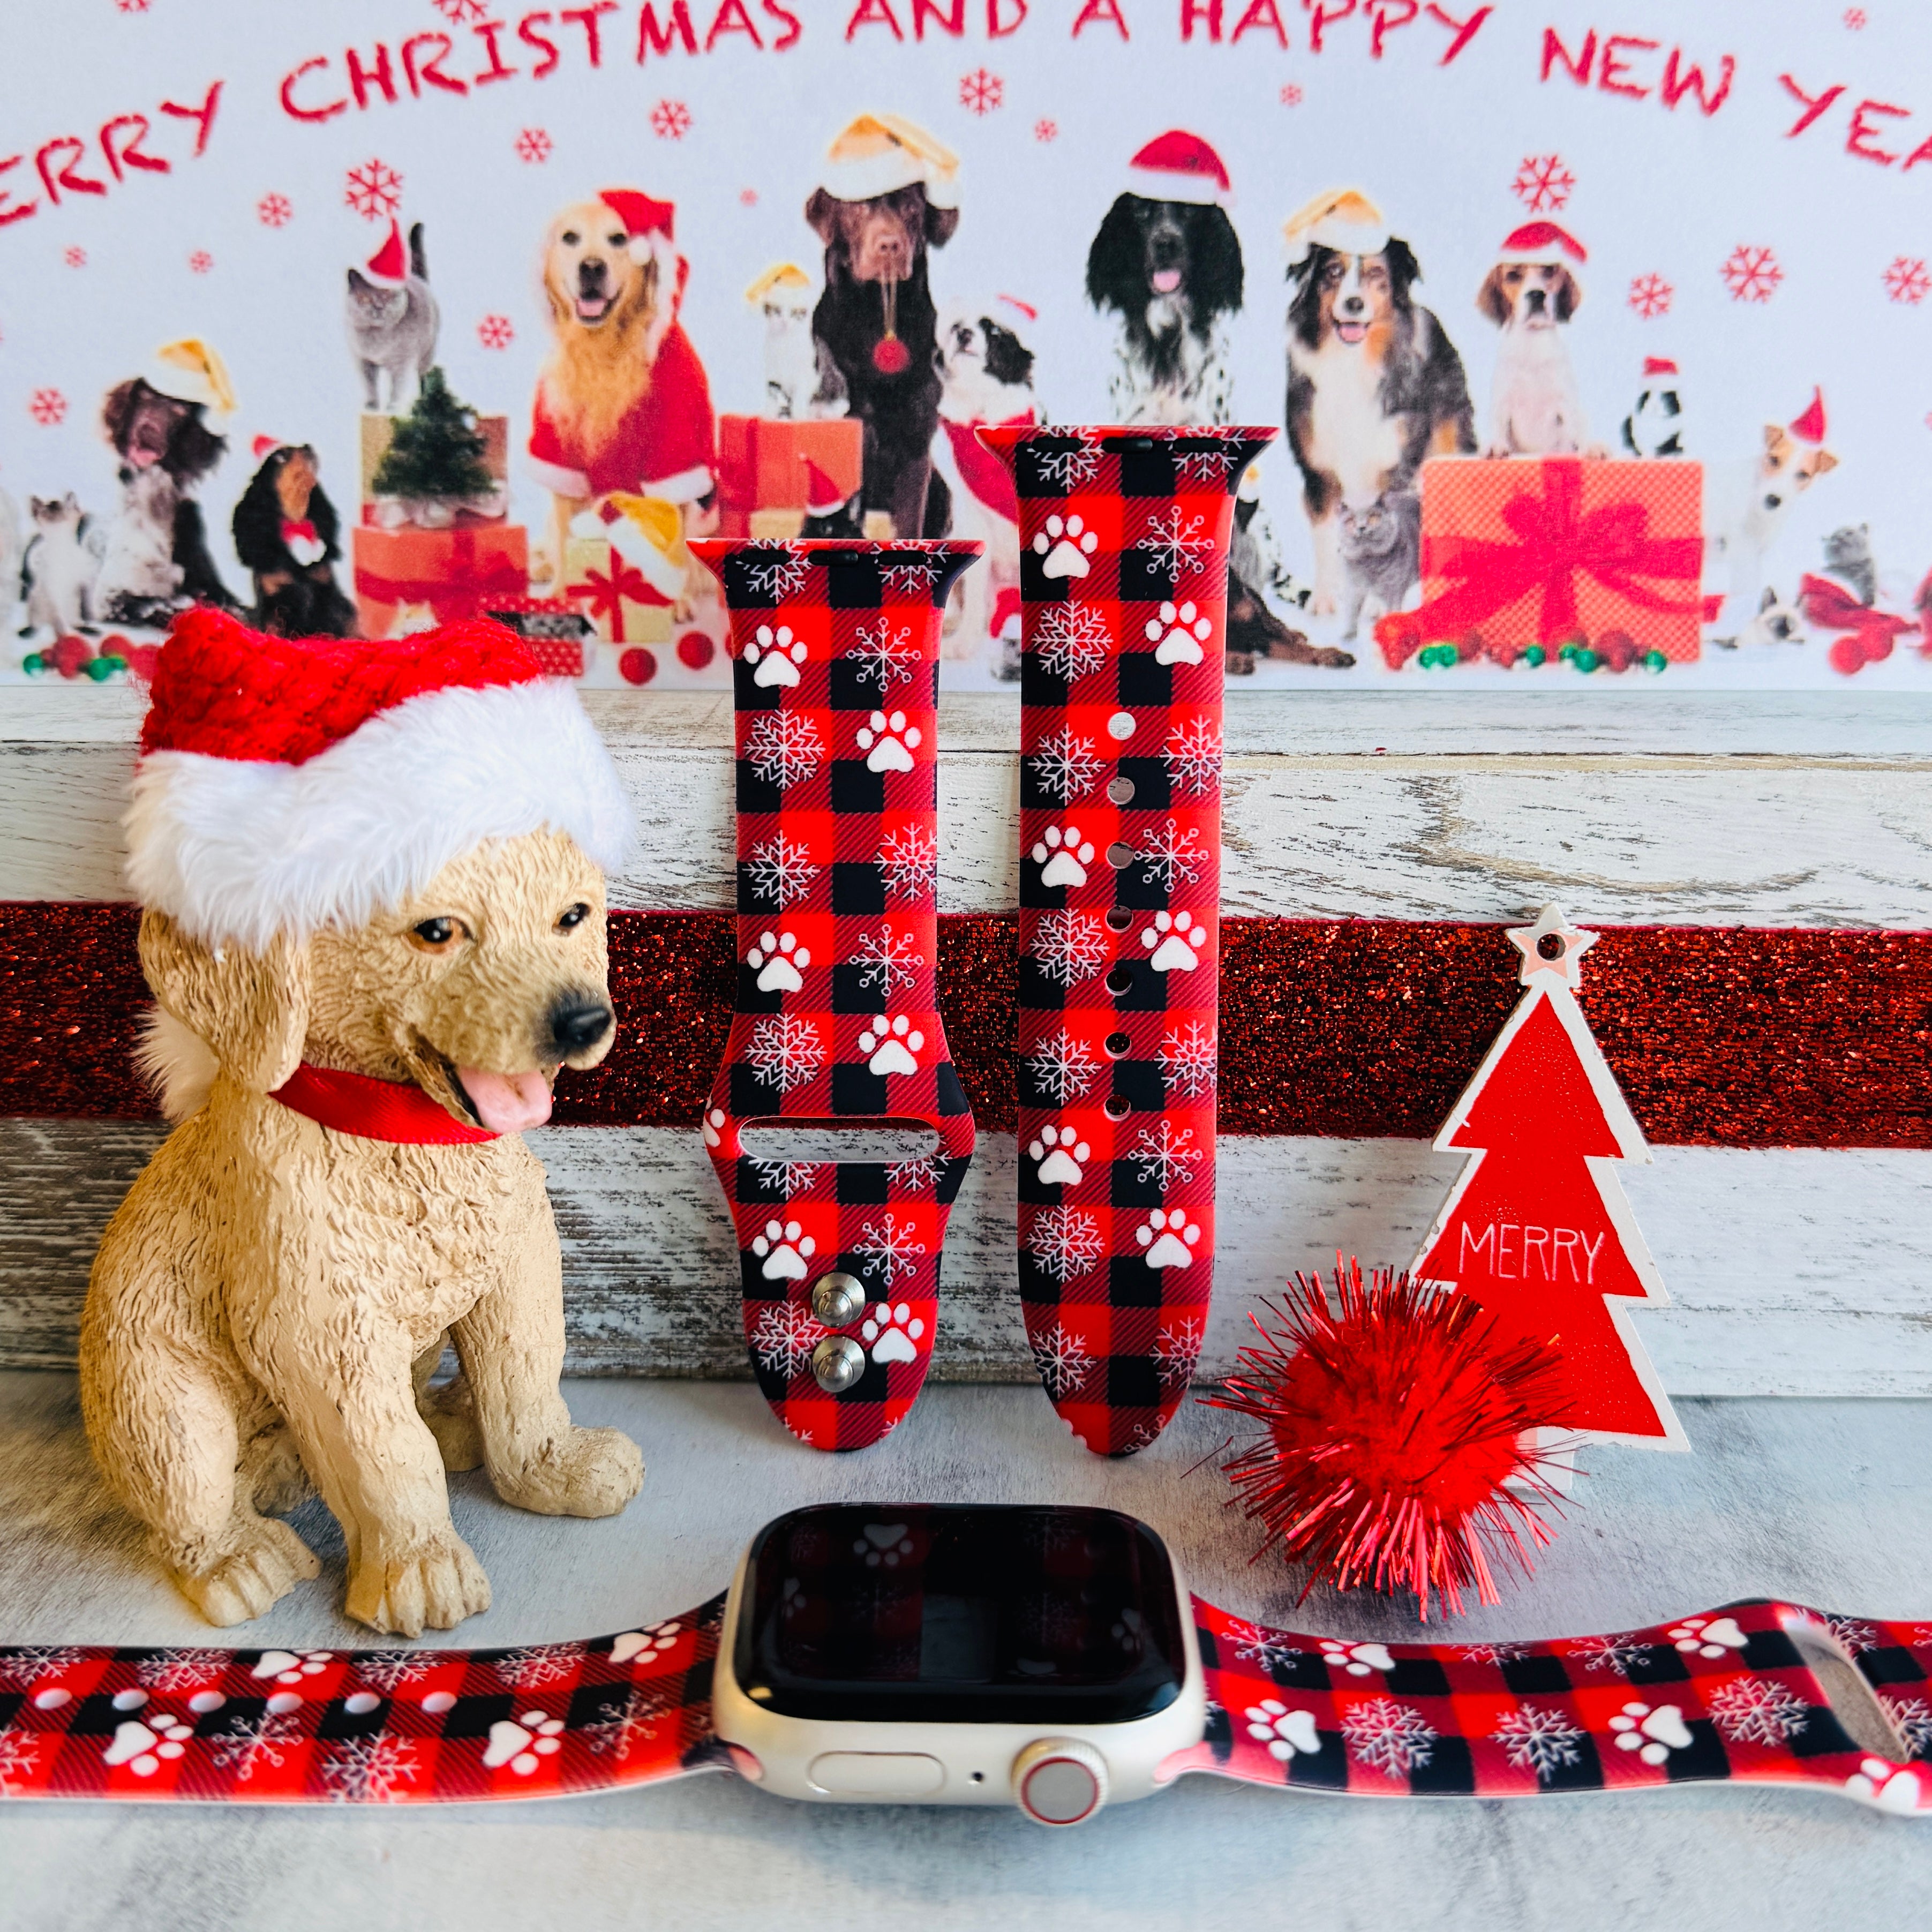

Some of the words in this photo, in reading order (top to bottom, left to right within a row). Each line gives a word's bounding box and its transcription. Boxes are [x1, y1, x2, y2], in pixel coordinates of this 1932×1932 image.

[279, 0, 803, 123] CHRISTMAS
[845, 0, 1029, 42] AND
[1071, 0, 1130, 41] A
[1179, 0, 1495, 66] HAPPY
[1539, 26, 1736, 117] NEW
[1458, 1220, 1605, 1285] MERRY
